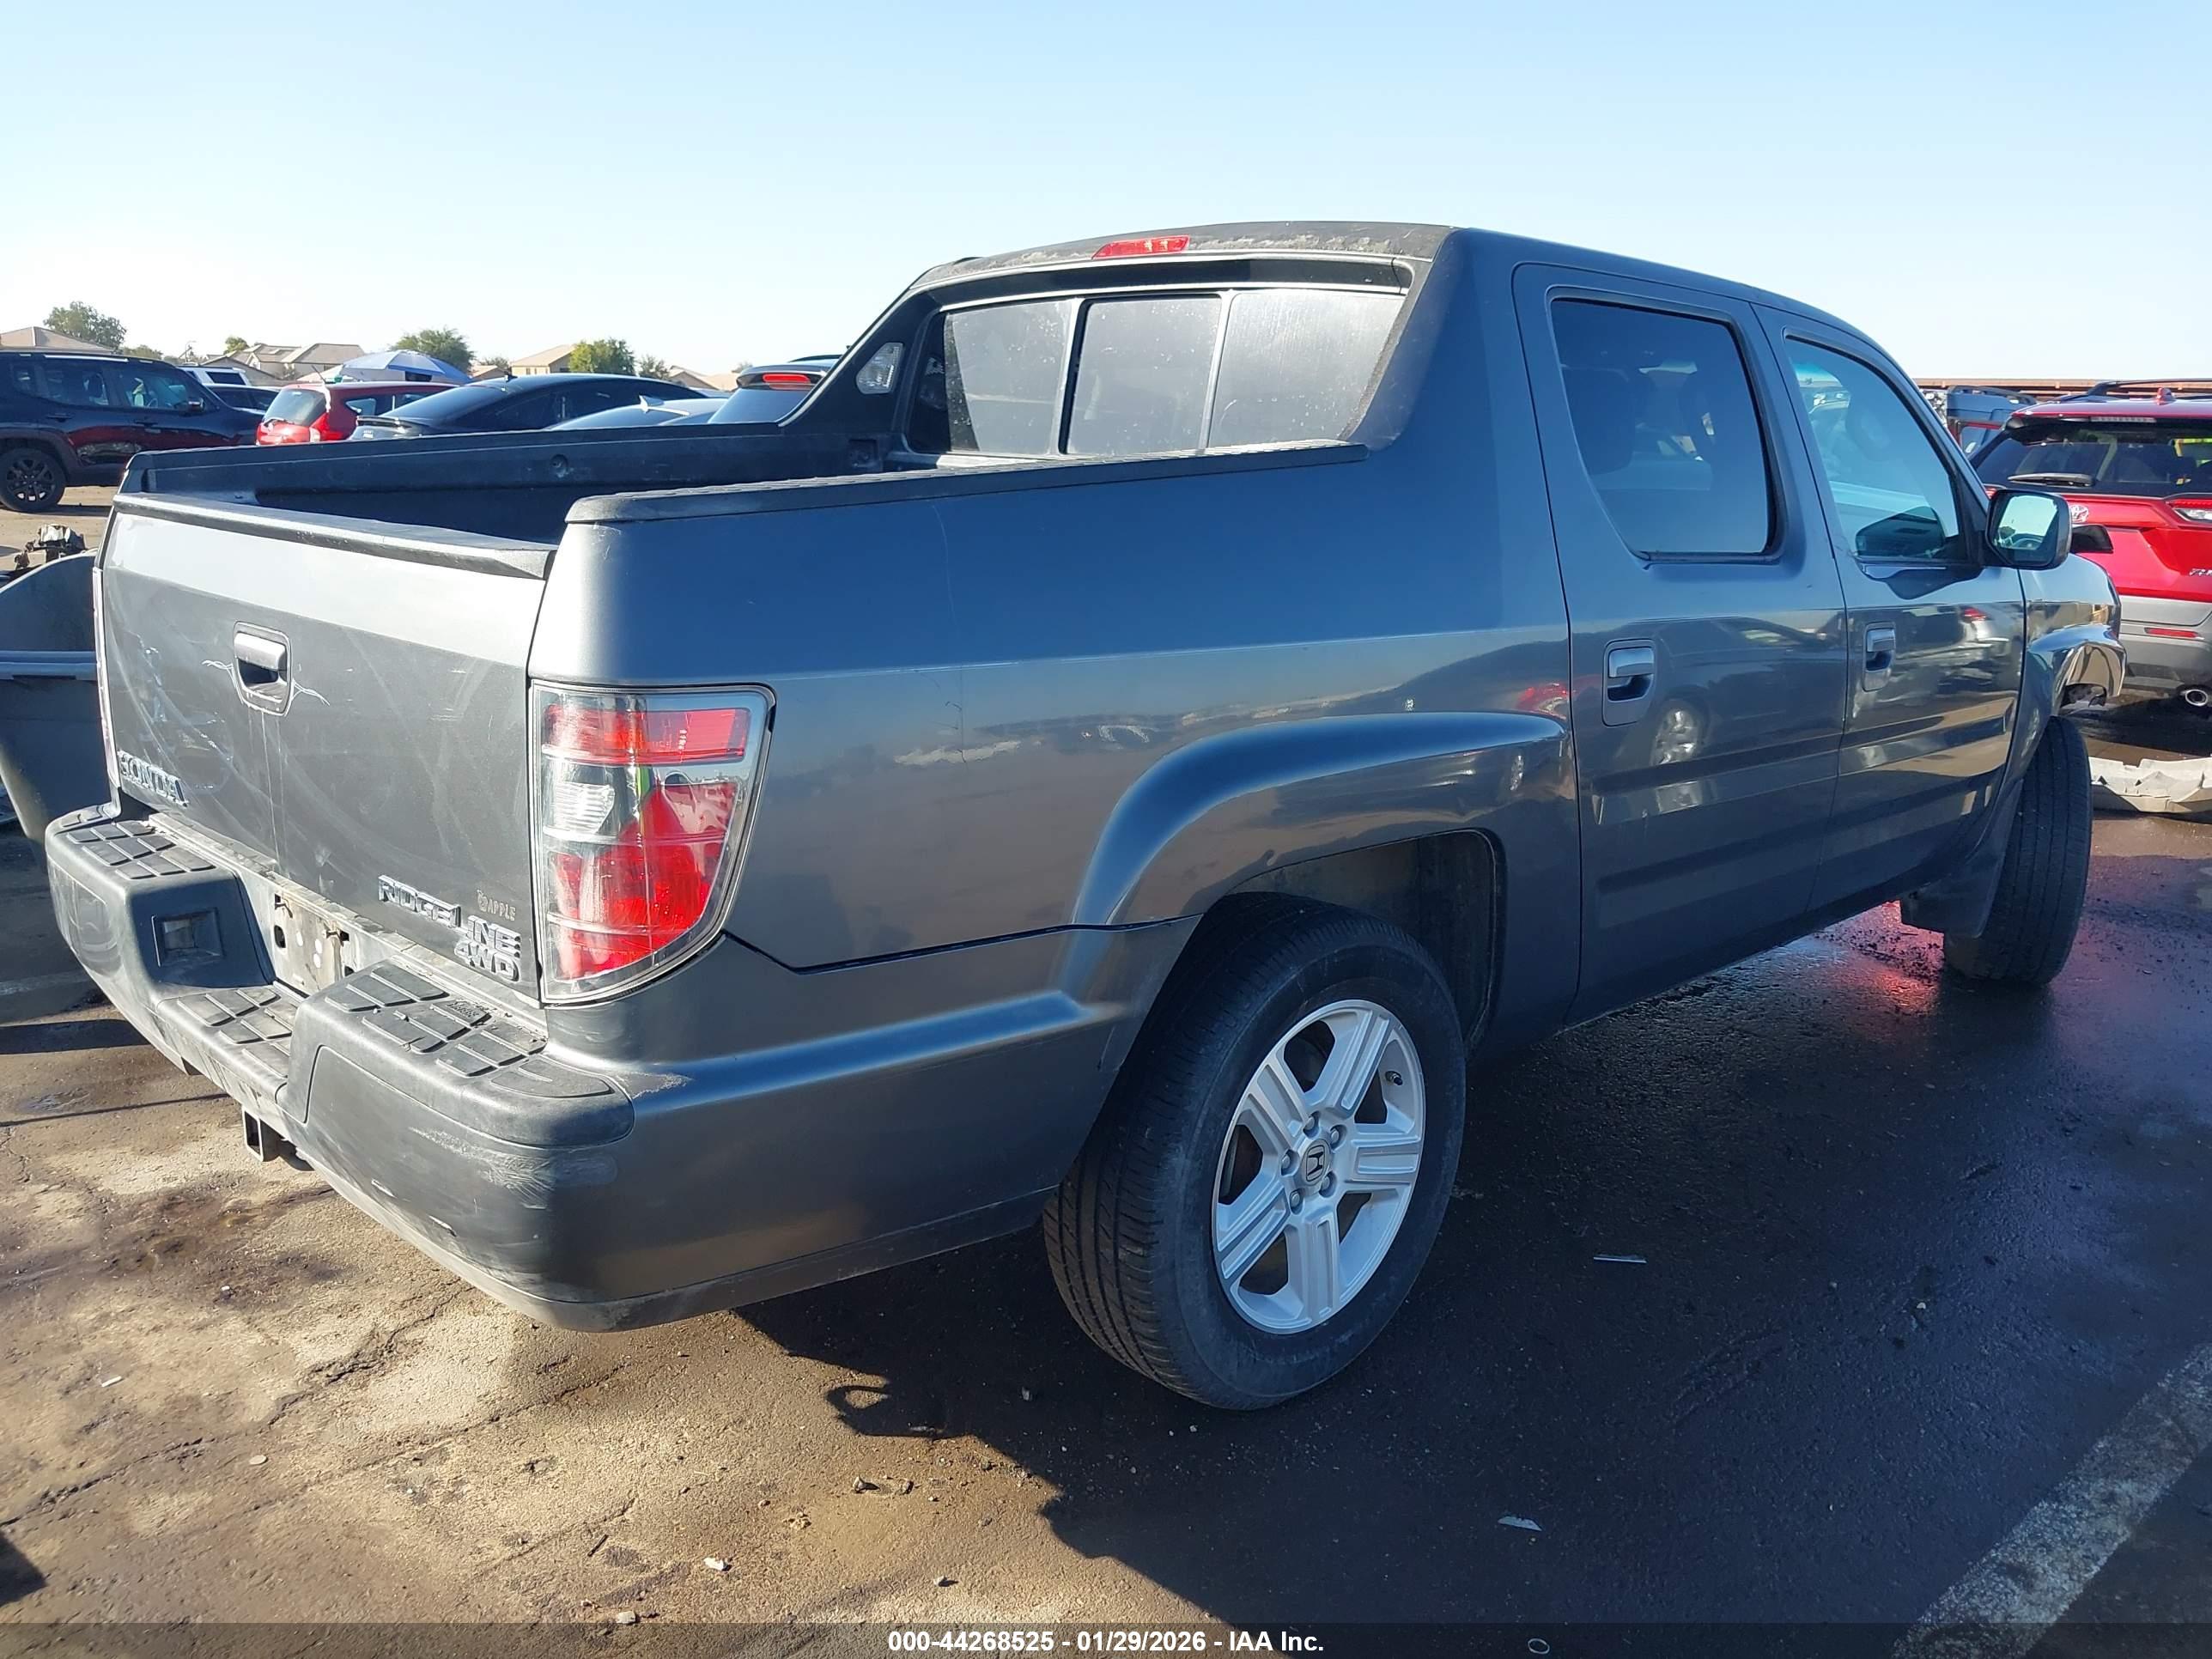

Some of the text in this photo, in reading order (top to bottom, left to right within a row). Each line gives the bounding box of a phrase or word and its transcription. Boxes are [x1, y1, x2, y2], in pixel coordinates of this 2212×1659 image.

[117, 750, 189, 807] HONDA
[487, 898, 516, 921] APPLE
[454, 939, 521, 983] 4WD
